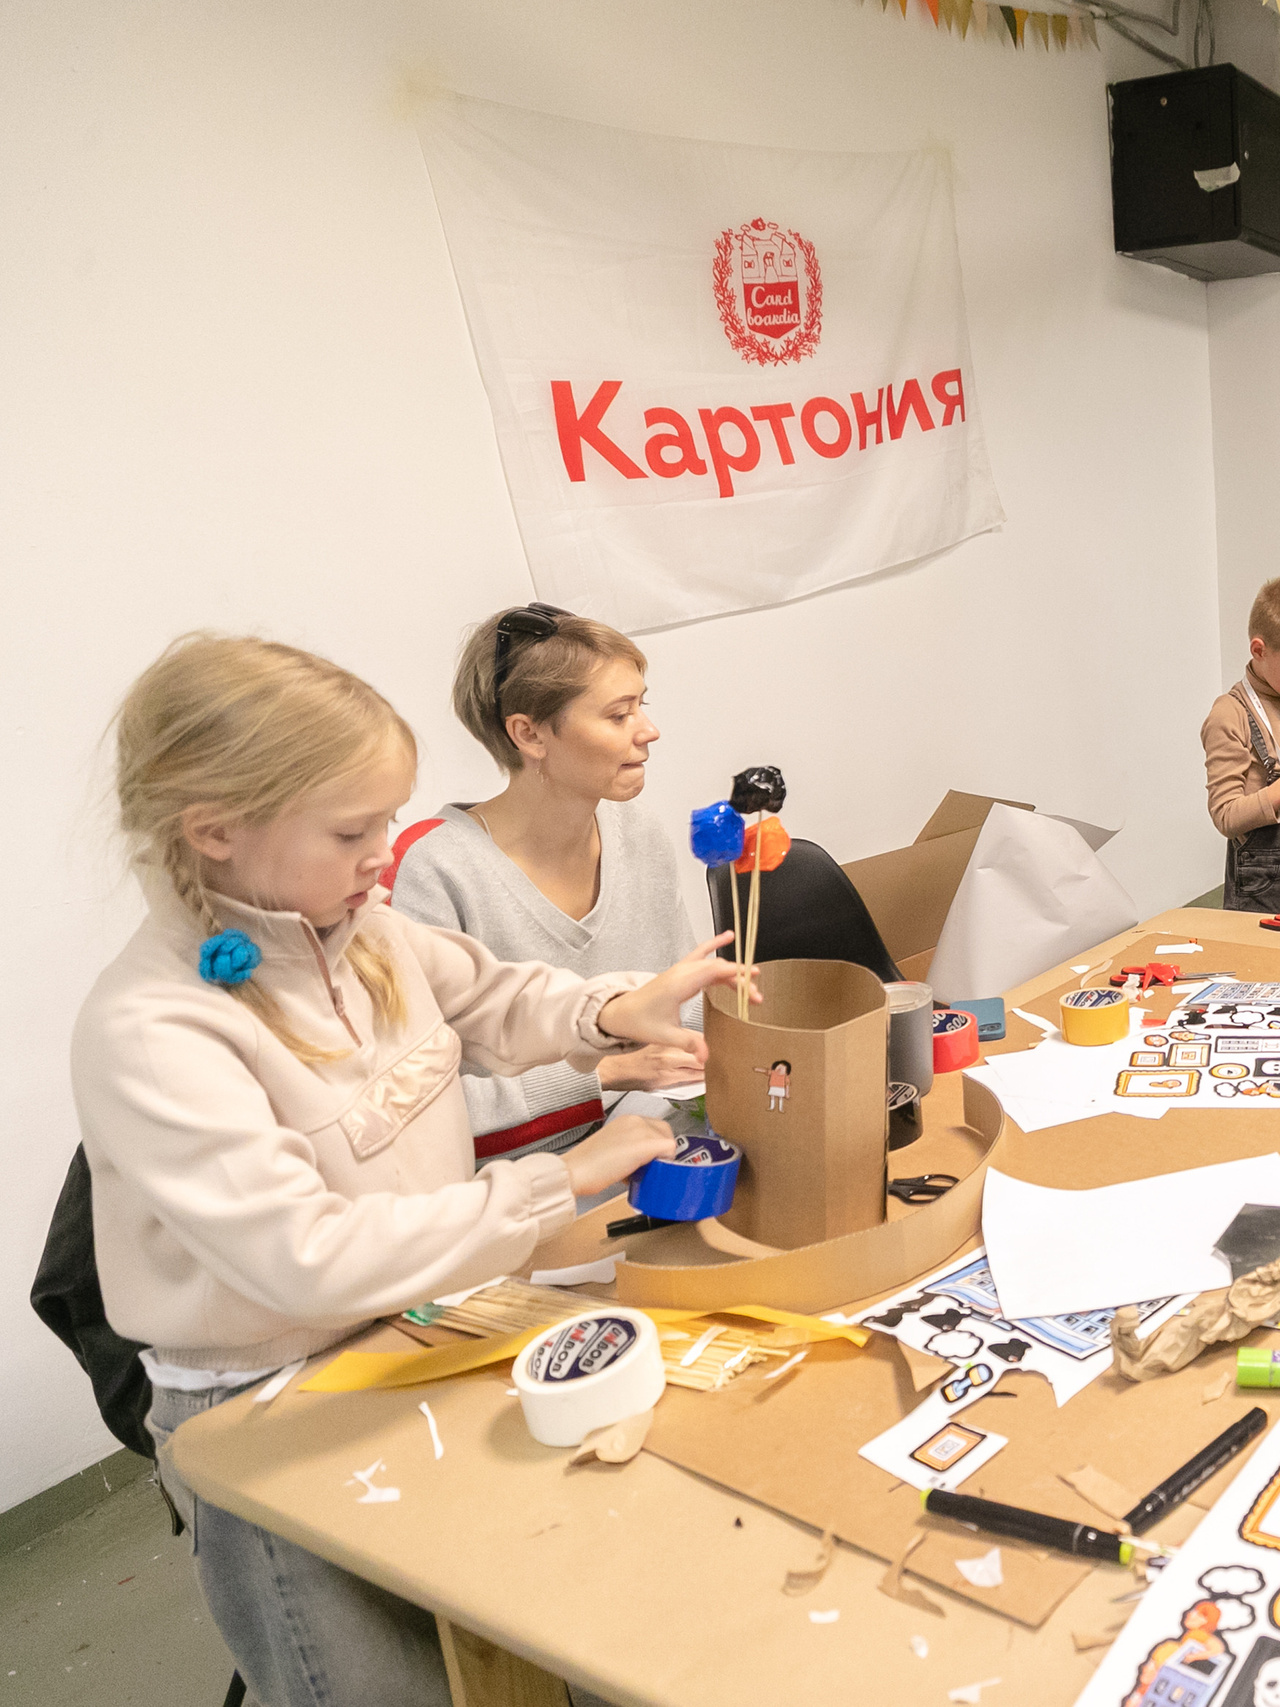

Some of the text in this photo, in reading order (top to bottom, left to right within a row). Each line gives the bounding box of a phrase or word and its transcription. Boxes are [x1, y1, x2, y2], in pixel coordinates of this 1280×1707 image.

[751, 286, 793, 308] Card
[746, 307, 800, 326] boardia
[550, 368, 966, 498] Картония
[583, 1327, 622, 1368] UNIBOB
